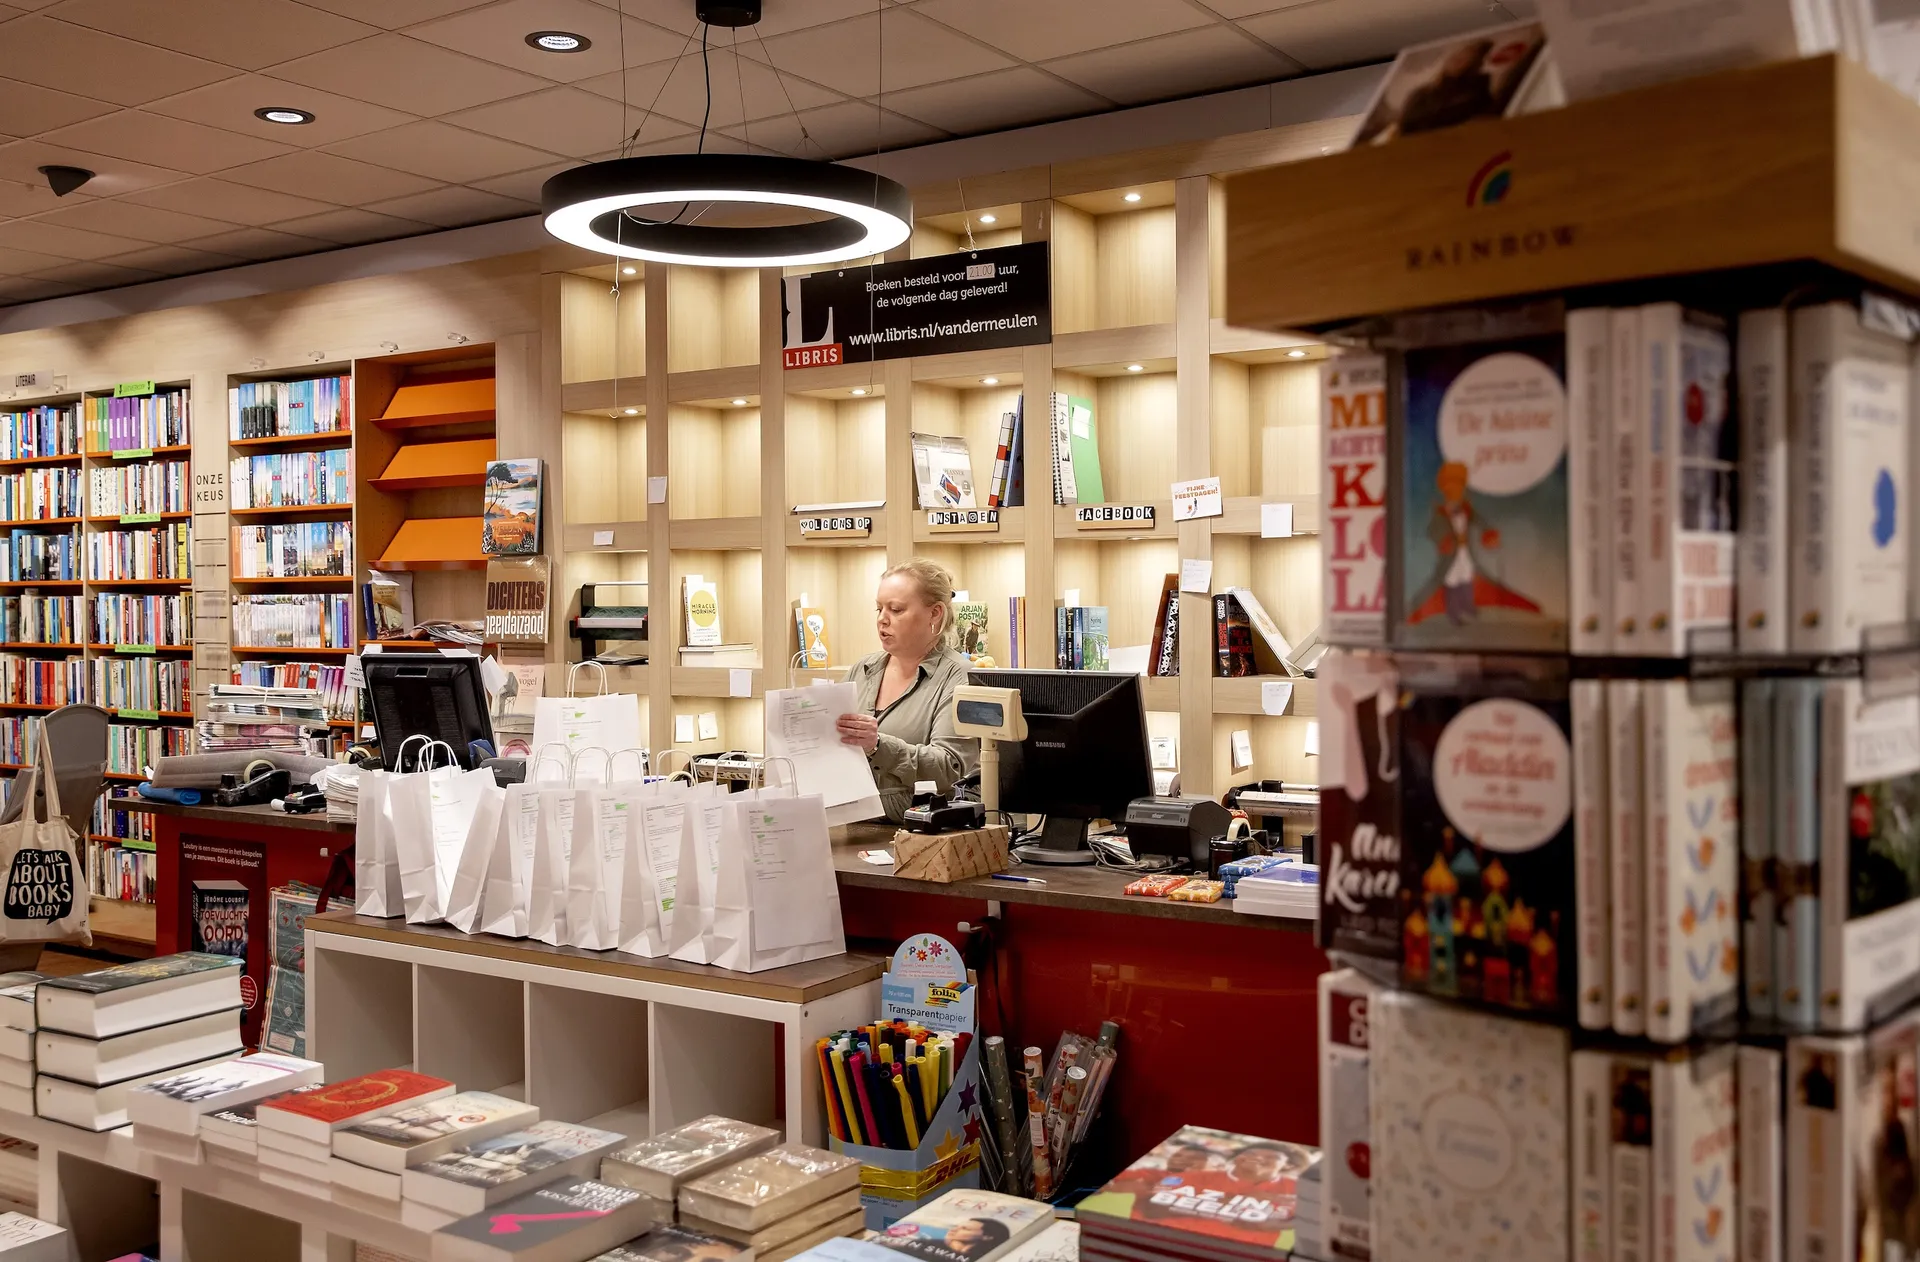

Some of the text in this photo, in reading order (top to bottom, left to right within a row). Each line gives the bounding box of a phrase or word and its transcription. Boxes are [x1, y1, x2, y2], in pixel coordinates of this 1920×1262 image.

[1406, 225, 1575, 271] RAINBOW
[866, 264, 1019, 292] Boeken besteld voor 21.00 uur,
[877, 282, 1008, 308] de volgende dag geleverd!
[849, 314, 1038, 346] www.libris.nl/vandermeulen
[785, 348, 838, 368] LIBRIS
[196, 474, 223, 485] ONZE
[197, 490, 224, 502] KEUS
[1175, 487, 1218, 499] FEESTDAGEN!
[487, 581, 545, 610] DICHTERS
[959, 613, 984, 621] POSTMA
[961, 605, 983, 613] ARJAN
[485, 611, 544, 640] poëzieplaat
[519, 677, 537, 687] vogel
[1035, 741, 1066, 749] SAMSUNG
[43, 852, 63, 864] ALK
[12, 862, 69, 884] ABOUT
[9, 882, 72, 906] BOOKS
[28, 904, 60, 918] BABY
[200, 910, 248, 920] TOEVLUCHTS
[204, 925, 244, 942] OORD
[932, 988, 957, 999] folia
[888, 1003, 967, 1023] Transparentpapier
[1150, 1191, 1271, 1222] BEELD
[1170, 1185, 1271, 1210] AZ IN
[926, 1244, 970, 1262] SWAN
